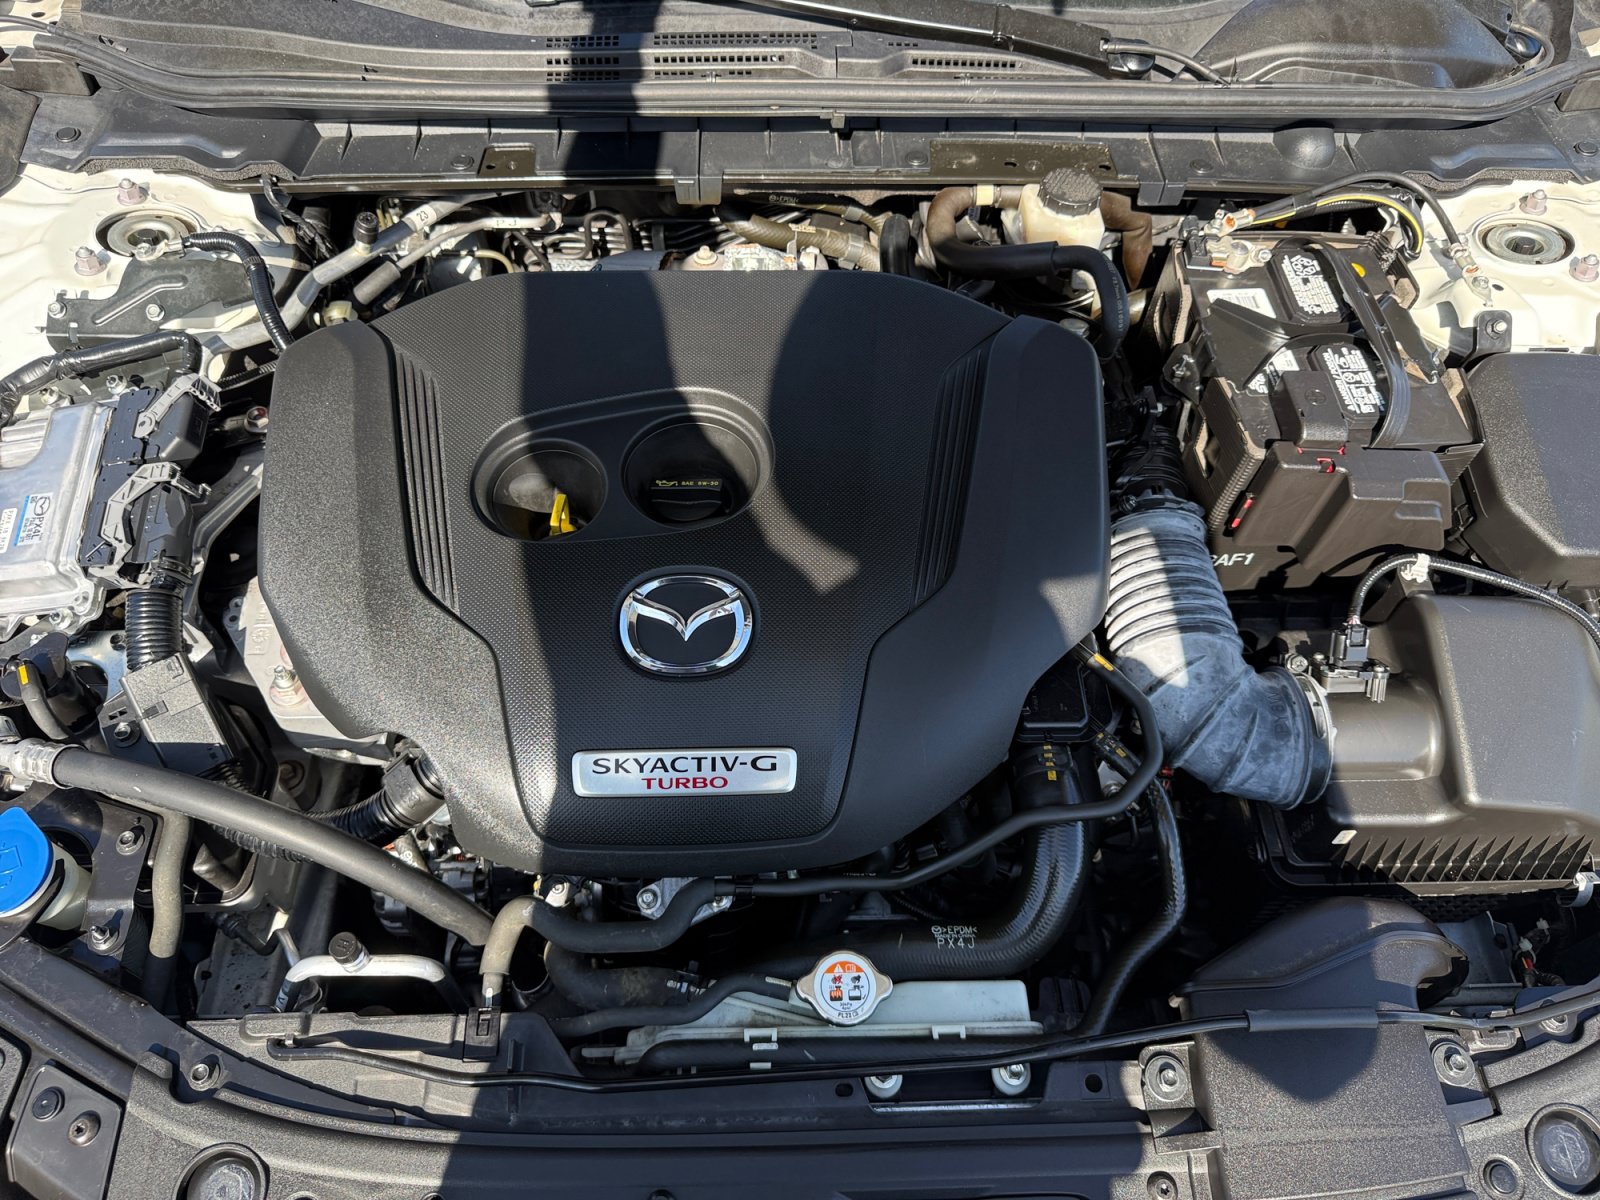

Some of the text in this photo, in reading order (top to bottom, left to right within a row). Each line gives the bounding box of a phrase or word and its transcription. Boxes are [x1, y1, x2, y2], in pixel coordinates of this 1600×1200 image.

[416, 210, 429, 222] 23
[592, 755, 777, 774] SKYACTIV-G
[641, 776, 728, 790] TURBO
[937, 937, 975, 949] PX4J
